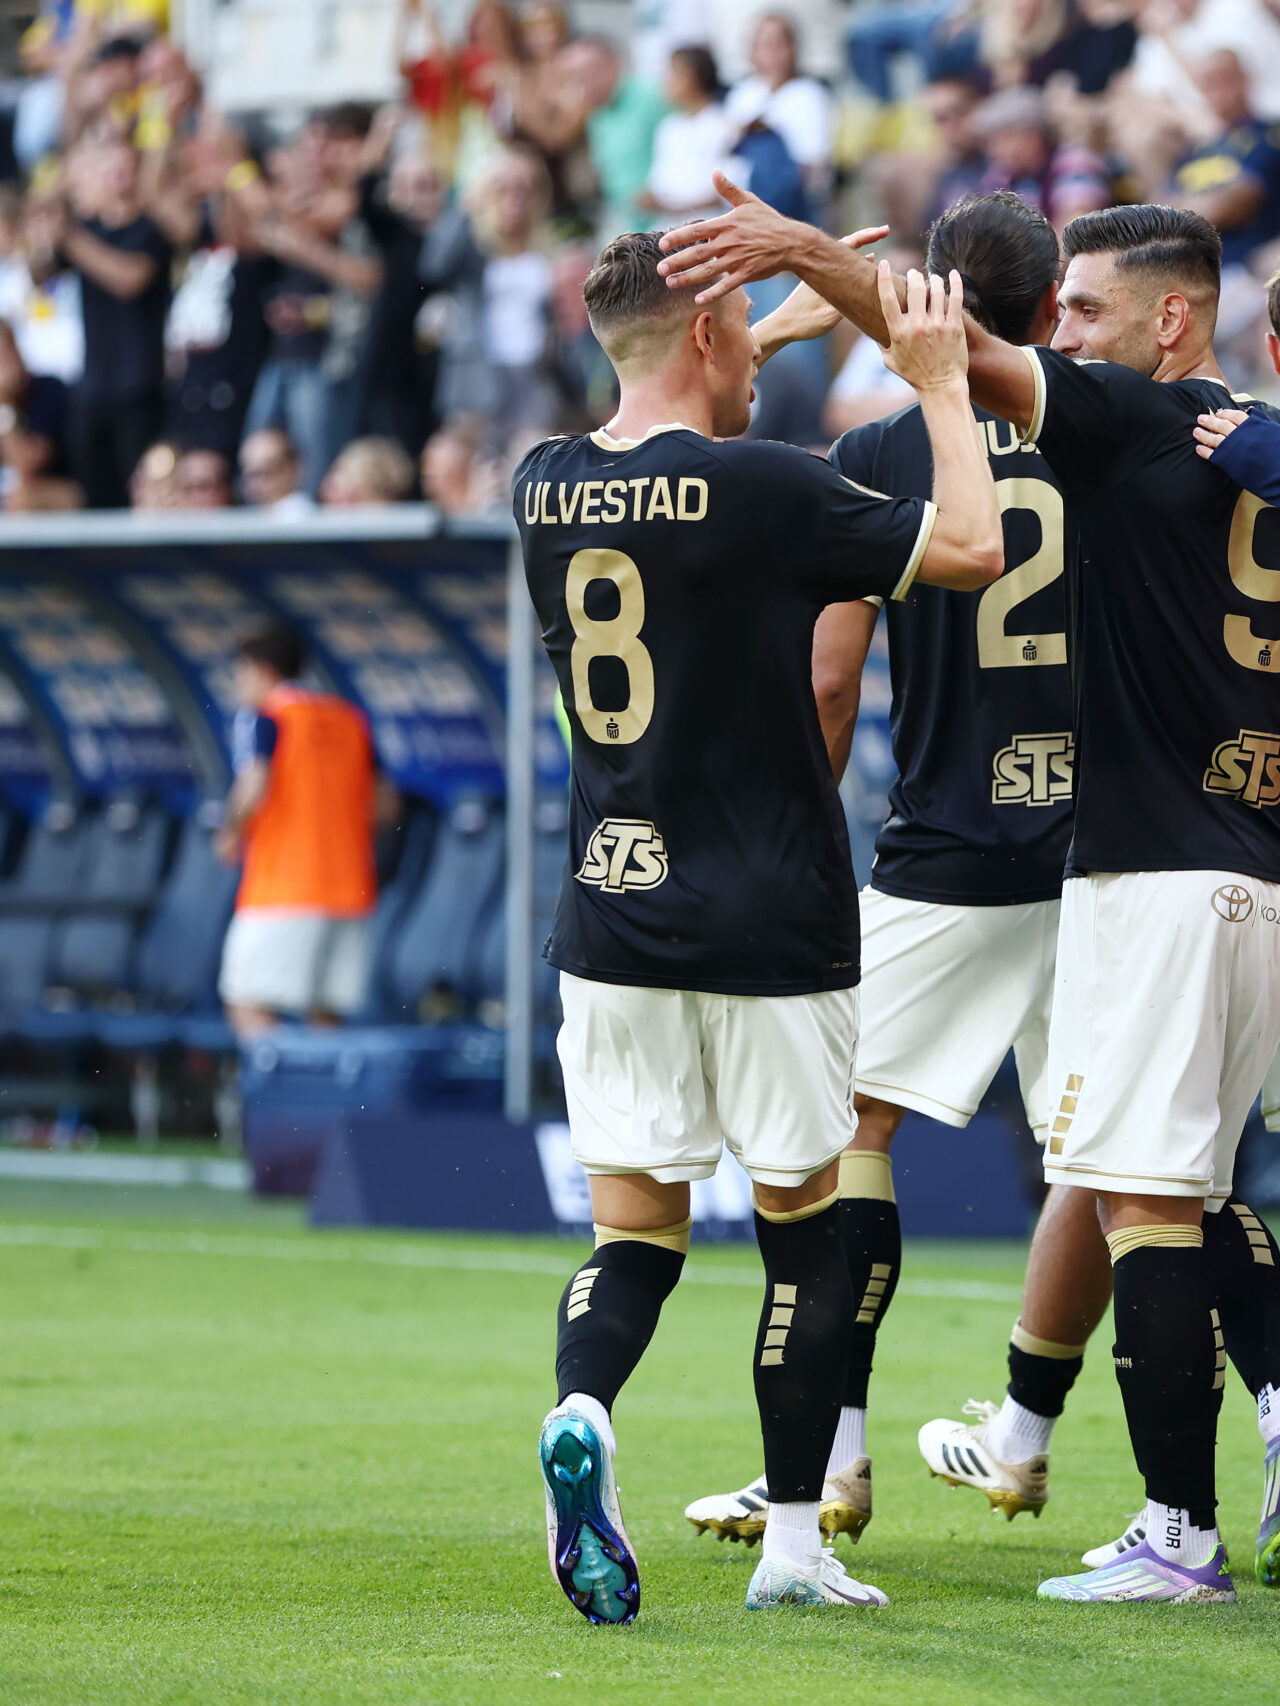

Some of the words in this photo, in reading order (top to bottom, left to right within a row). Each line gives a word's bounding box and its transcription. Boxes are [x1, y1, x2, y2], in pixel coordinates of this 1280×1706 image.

[525, 477, 709, 525] ULVESTAD
[977, 477, 1067, 668] 2
[565, 548, 656, 745] 8
[574, 818, 669, 893] STS
[1166, 1505, 1181, 1549] CTOR
